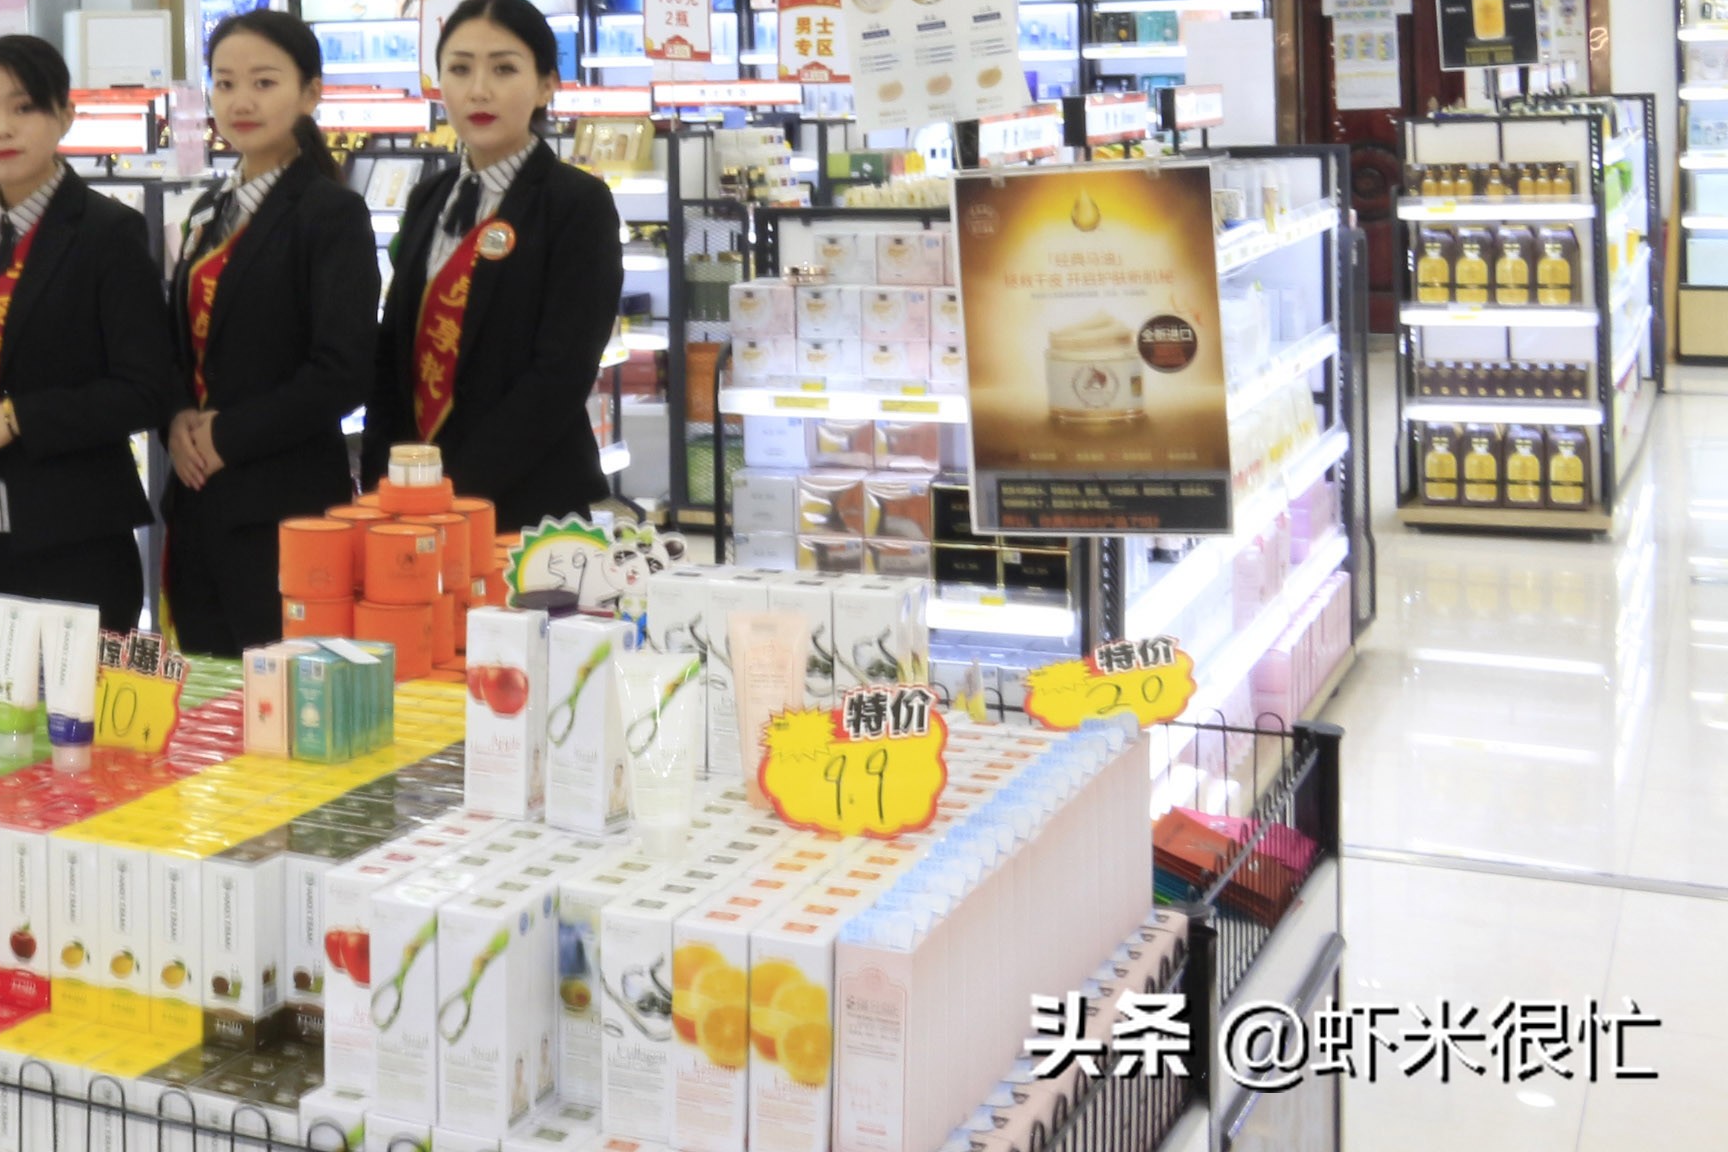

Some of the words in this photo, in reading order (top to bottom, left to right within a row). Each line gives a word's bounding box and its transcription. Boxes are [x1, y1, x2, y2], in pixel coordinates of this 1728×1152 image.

[795, 16, 835, 35] 男士
[794, 38, 835, 57] 专区
[1096, 638, 1178, 673] 特价
[1086, 674, 1164, 714] 20
[844, 689, 934, 738] 特价
